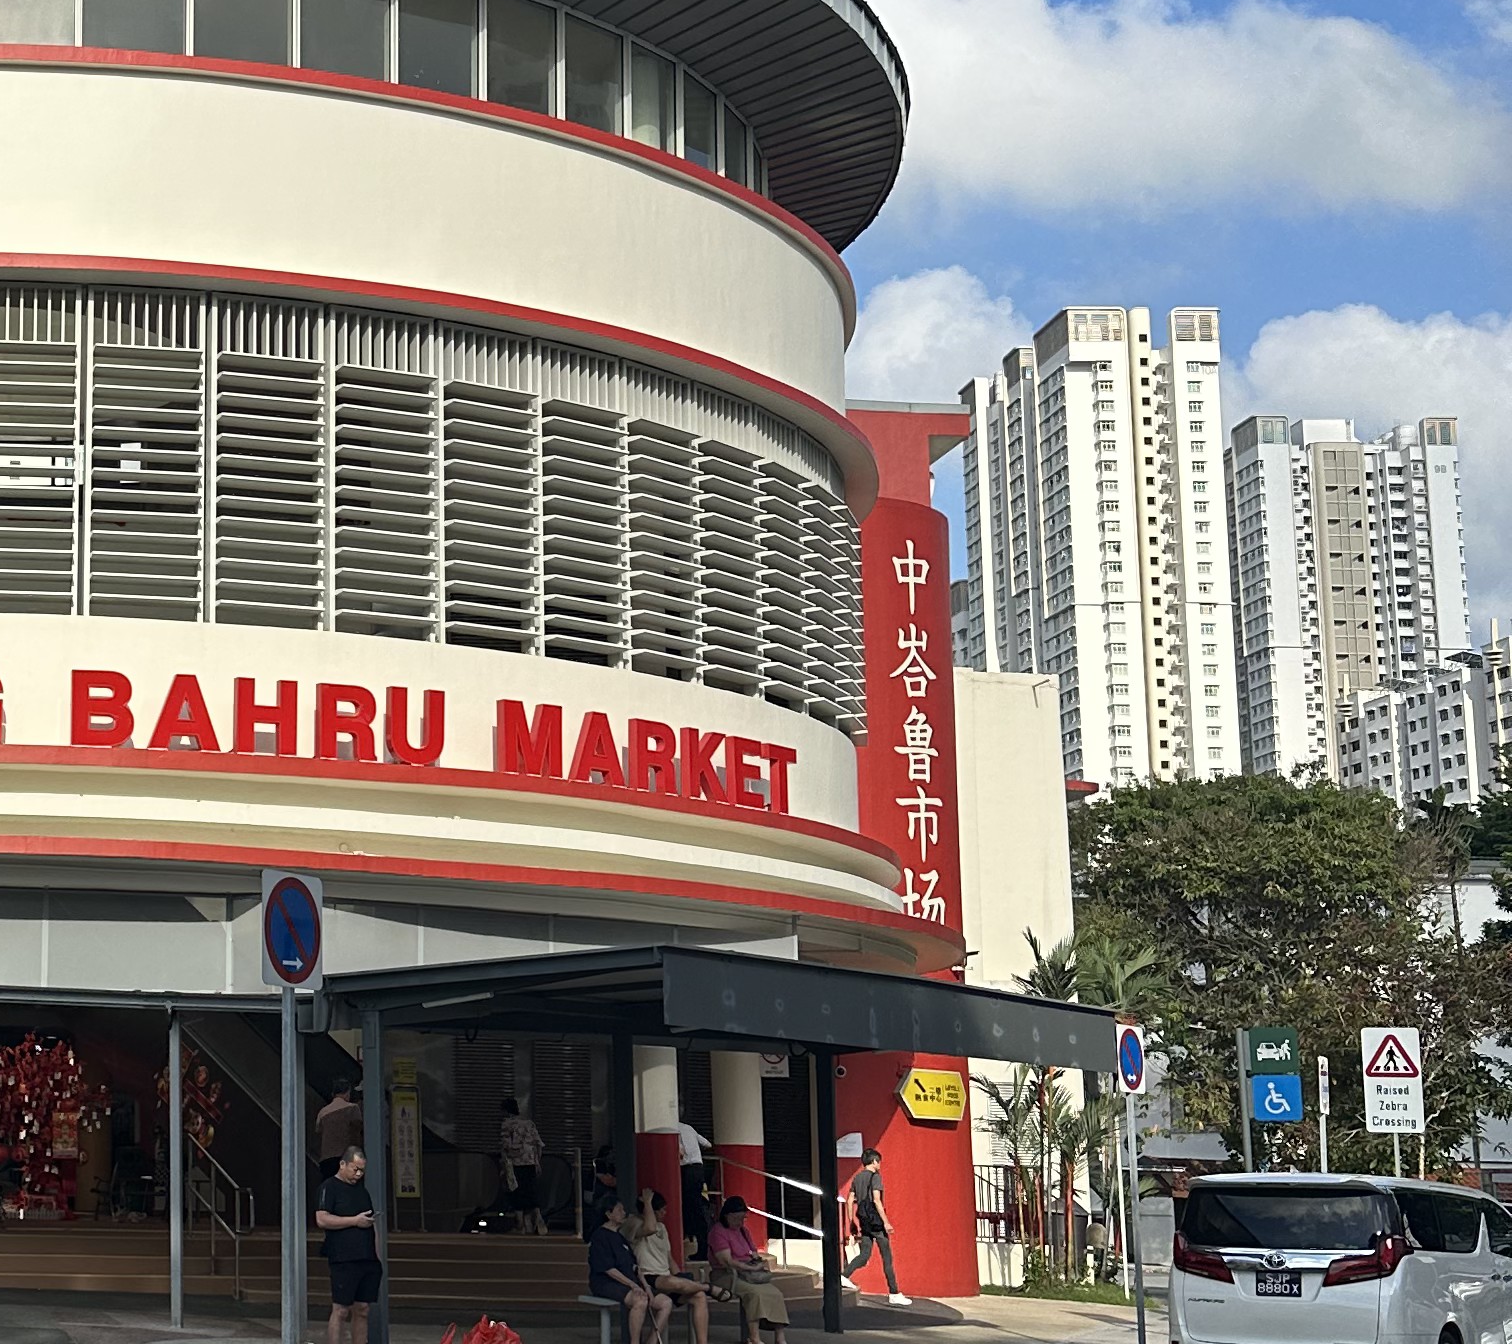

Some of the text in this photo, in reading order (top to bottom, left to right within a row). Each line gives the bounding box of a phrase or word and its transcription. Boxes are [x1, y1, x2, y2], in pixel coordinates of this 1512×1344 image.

[70, 669, 446, 766] BAHRU
[496, 698, 797, 815] MARKET
[1376, 1084, 1410, 1096] Raised
[1379, 1100, 1408, 1111] Zebra
[1372, 1116, 1417, 1130] Crossing
[1266, 1273, 1290, 1283] SJP
